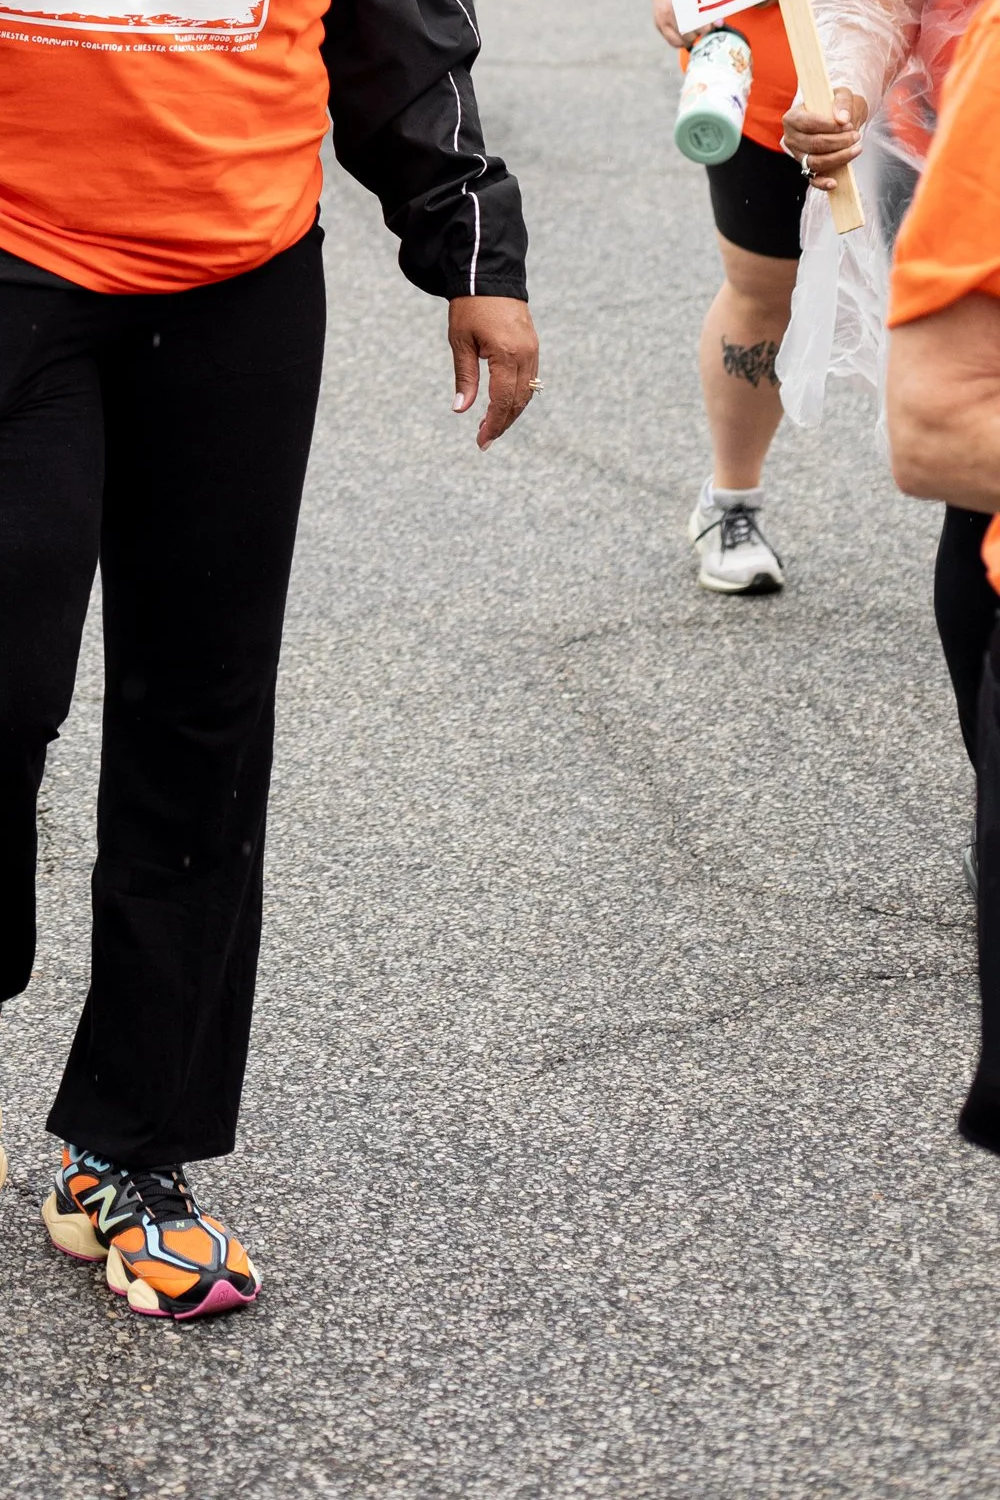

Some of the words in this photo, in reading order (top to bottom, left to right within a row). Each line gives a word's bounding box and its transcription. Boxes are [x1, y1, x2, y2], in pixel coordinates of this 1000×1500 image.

[31, 35, 79, 47] COMMUNITY
[81, 41, 123, 52] COALITION
[133, 43, 166, 52] CHESTER
